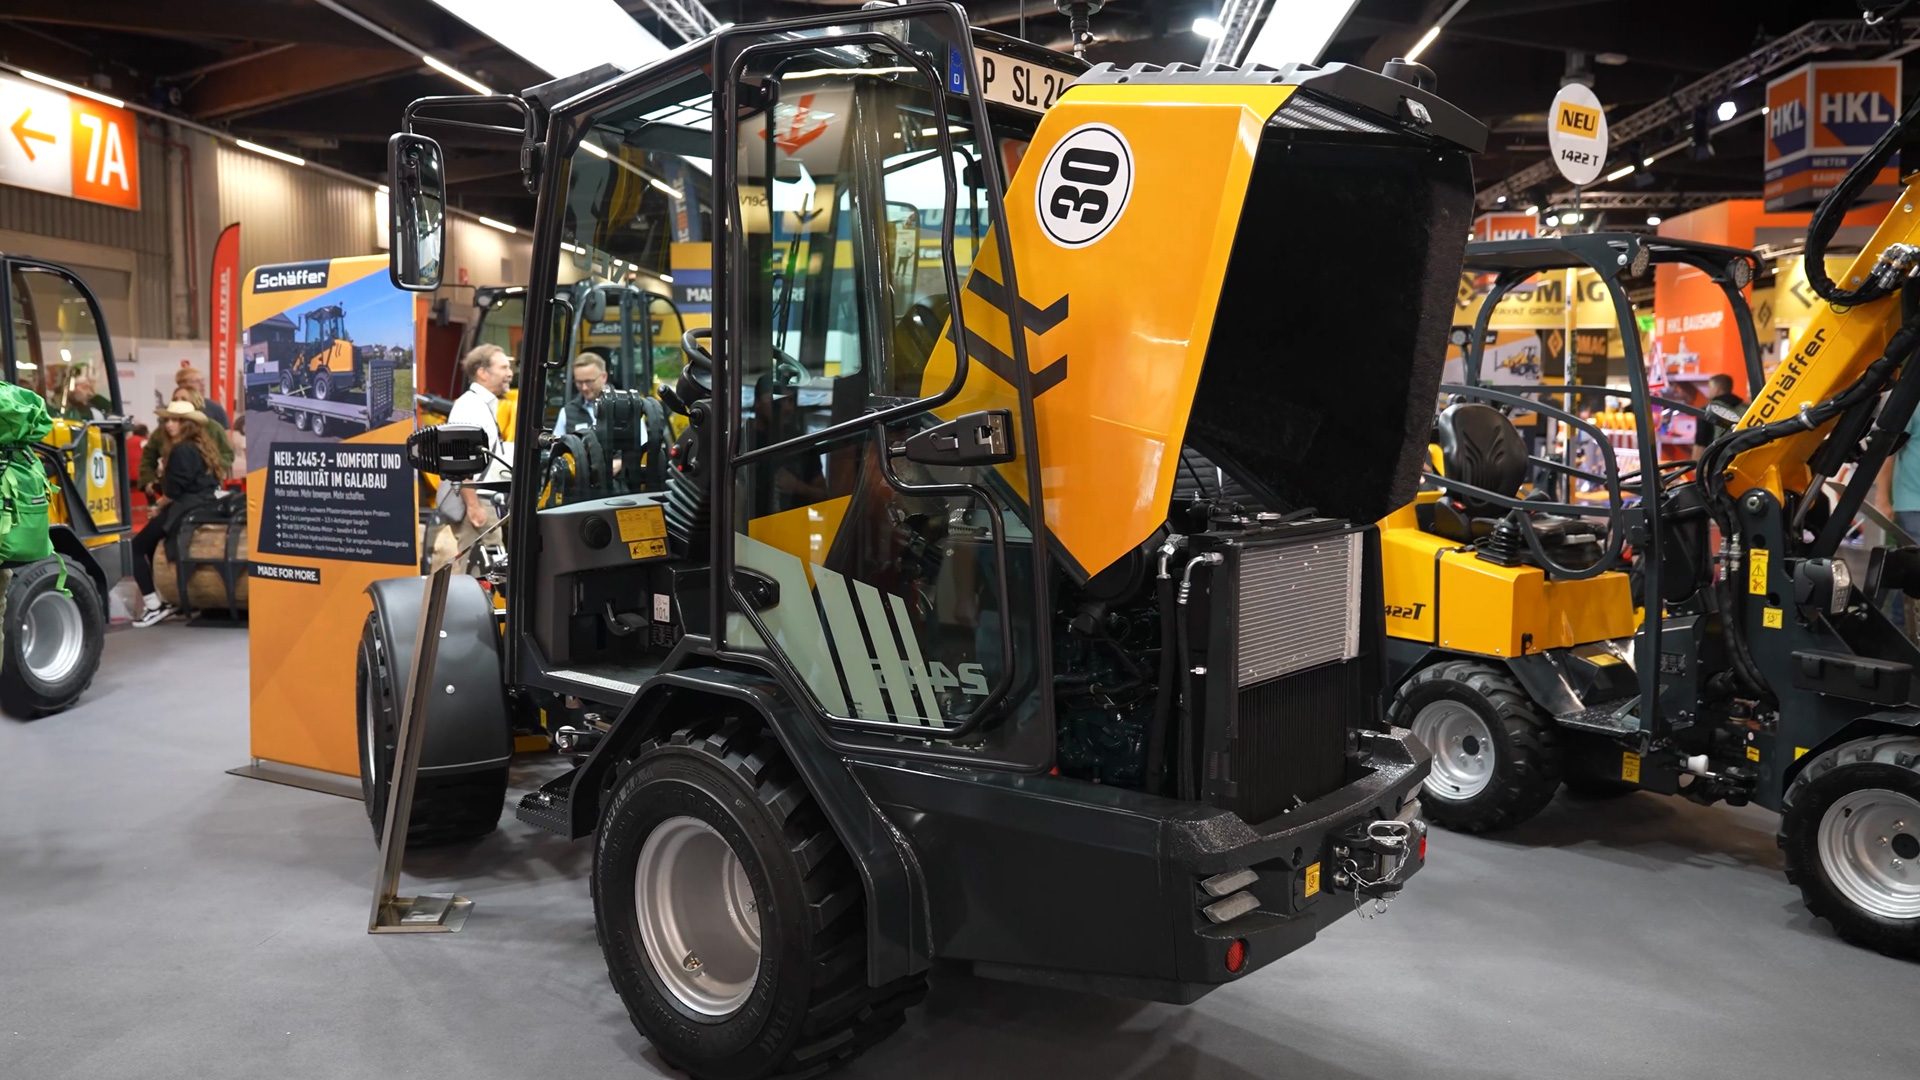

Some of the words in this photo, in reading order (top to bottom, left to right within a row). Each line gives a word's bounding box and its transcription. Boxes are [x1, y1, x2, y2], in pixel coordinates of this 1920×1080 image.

[954, 73, 960, 84] D
[982, 56, 996, 94] P
[1012, 66, 1038, 106] SL
[1770, 98, 1804, 139] HKL
[1820, 91, 1890, 124] HKL
[1562, 109, 1596, 132] NEU
[80, 112, 129, 191] 7A
[1562, 149, 1590, 165] 1422
[1592, 155, 1599, 166] T
[1050, 147, 1119, 224] 30
[256, 270, 326, 288] Schäffer
[1746, 328, 1826, 427] Schäffer
[94, 456, 104, 479] 20
[274, 452, 294, 466] NEU:
[296, 452, 326, 467] 2445-2
[336, 452, 378, 468] KOMFORT
[381, 454, 401, 469] UND
[275, 469, 329, 486] FLEXIBILITÄT
[331, 473, 342, 487] IM
[344, 473, 387, 489] GALABAU
[257, 566, 277, 577] MADE
[279, 567, 293, 578] FOR
[295, 569, 318, 581] MORE.
[1384, 602, 1426, 620] 422T
